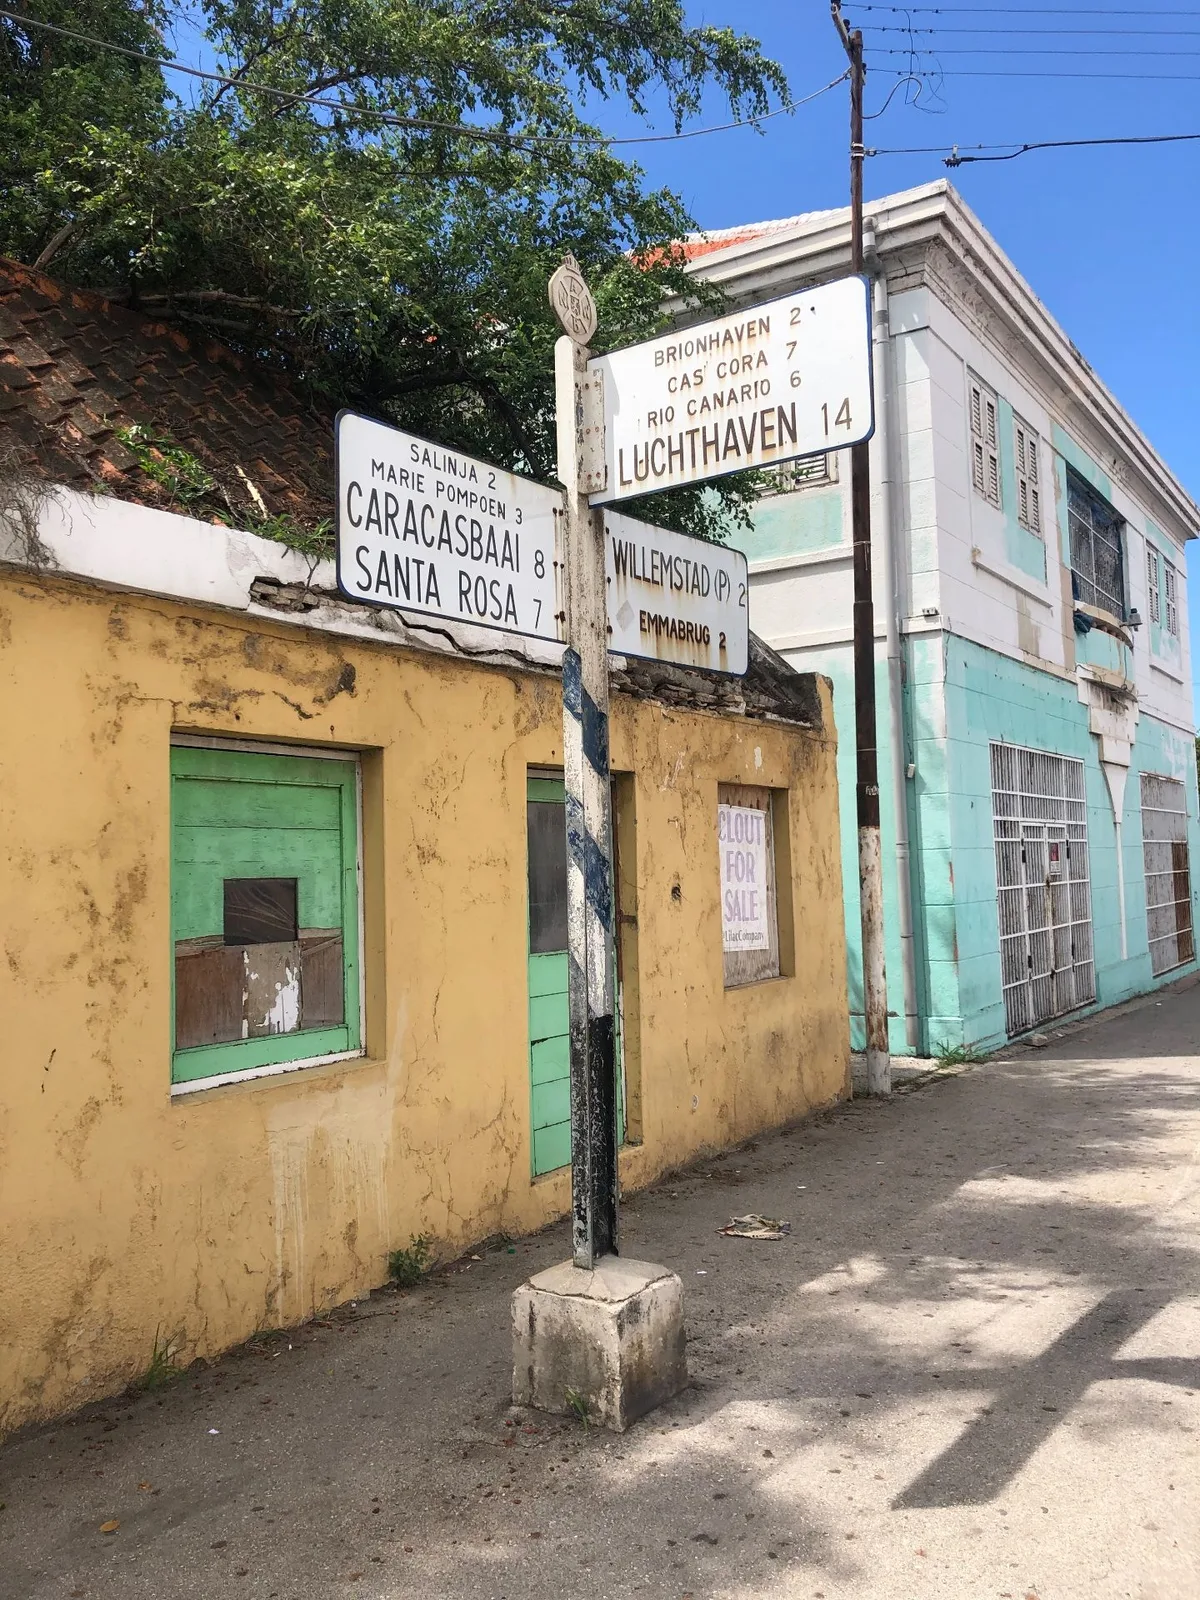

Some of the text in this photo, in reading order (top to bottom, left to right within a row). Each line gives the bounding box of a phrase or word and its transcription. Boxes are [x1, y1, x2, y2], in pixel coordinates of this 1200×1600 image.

[654, 307, 801, 367] BRIONHAVEN 2
[716, 350, 768, 379] CORA
[786, 341, 798, 360] 7
[648, 370, 802, 428] RIO CANARIO 6
[410, 443, 496, 490] SALINJA 2
[618, 397, 853, 486] LUCHTHAVEN 14
[371, 458, 523, 525] MARIE POMPOEN 3
[347, 481, 545, 579] CARACASBAAI 8
[355, 545, 542, 629] SANTA ROSA 7
[612, 537, 746, 607] WILLEMSTAD (P) 2
[639, 610, 726, 649] EMMABRUG 2
[725, 850, 755, 884] FOR
[725, 888, 759, 922] SALE
